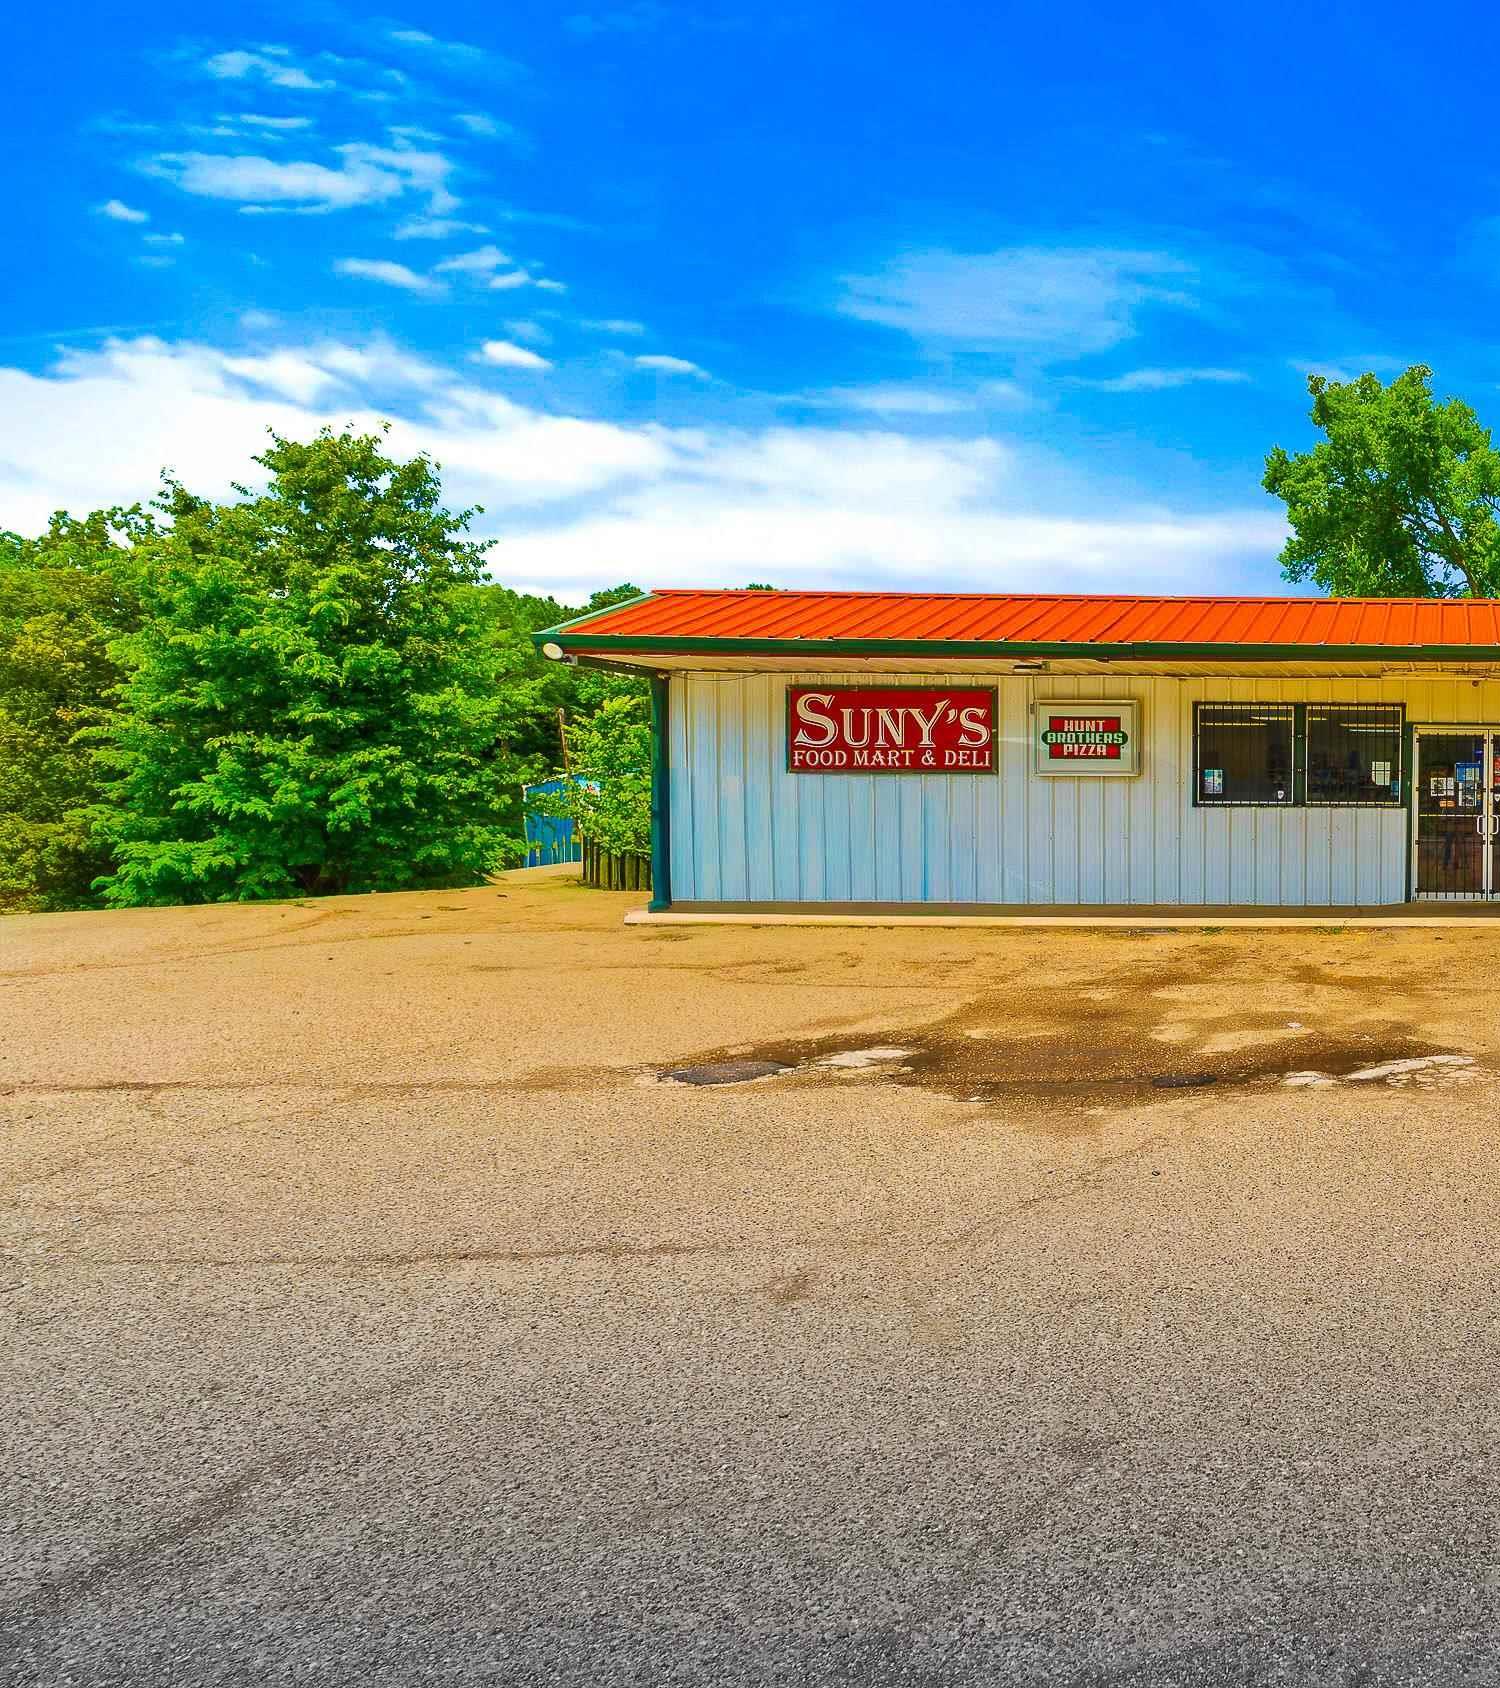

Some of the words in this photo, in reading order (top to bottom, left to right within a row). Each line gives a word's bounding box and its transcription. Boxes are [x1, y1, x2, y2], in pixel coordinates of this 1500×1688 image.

[794, 693, 990, 748] SUNY'S
[1063, 720, 1105, 732] HUNT
[1047, 732, 1123, 744] BROTHERS
[1063, 744, 1106, 756] PIZZA
[793, 750, 847, 767] FOOD
[853, 750, 914, 767] MART
[921, 749, 937, 767] &
[944, 750, 991, 767] DELI
